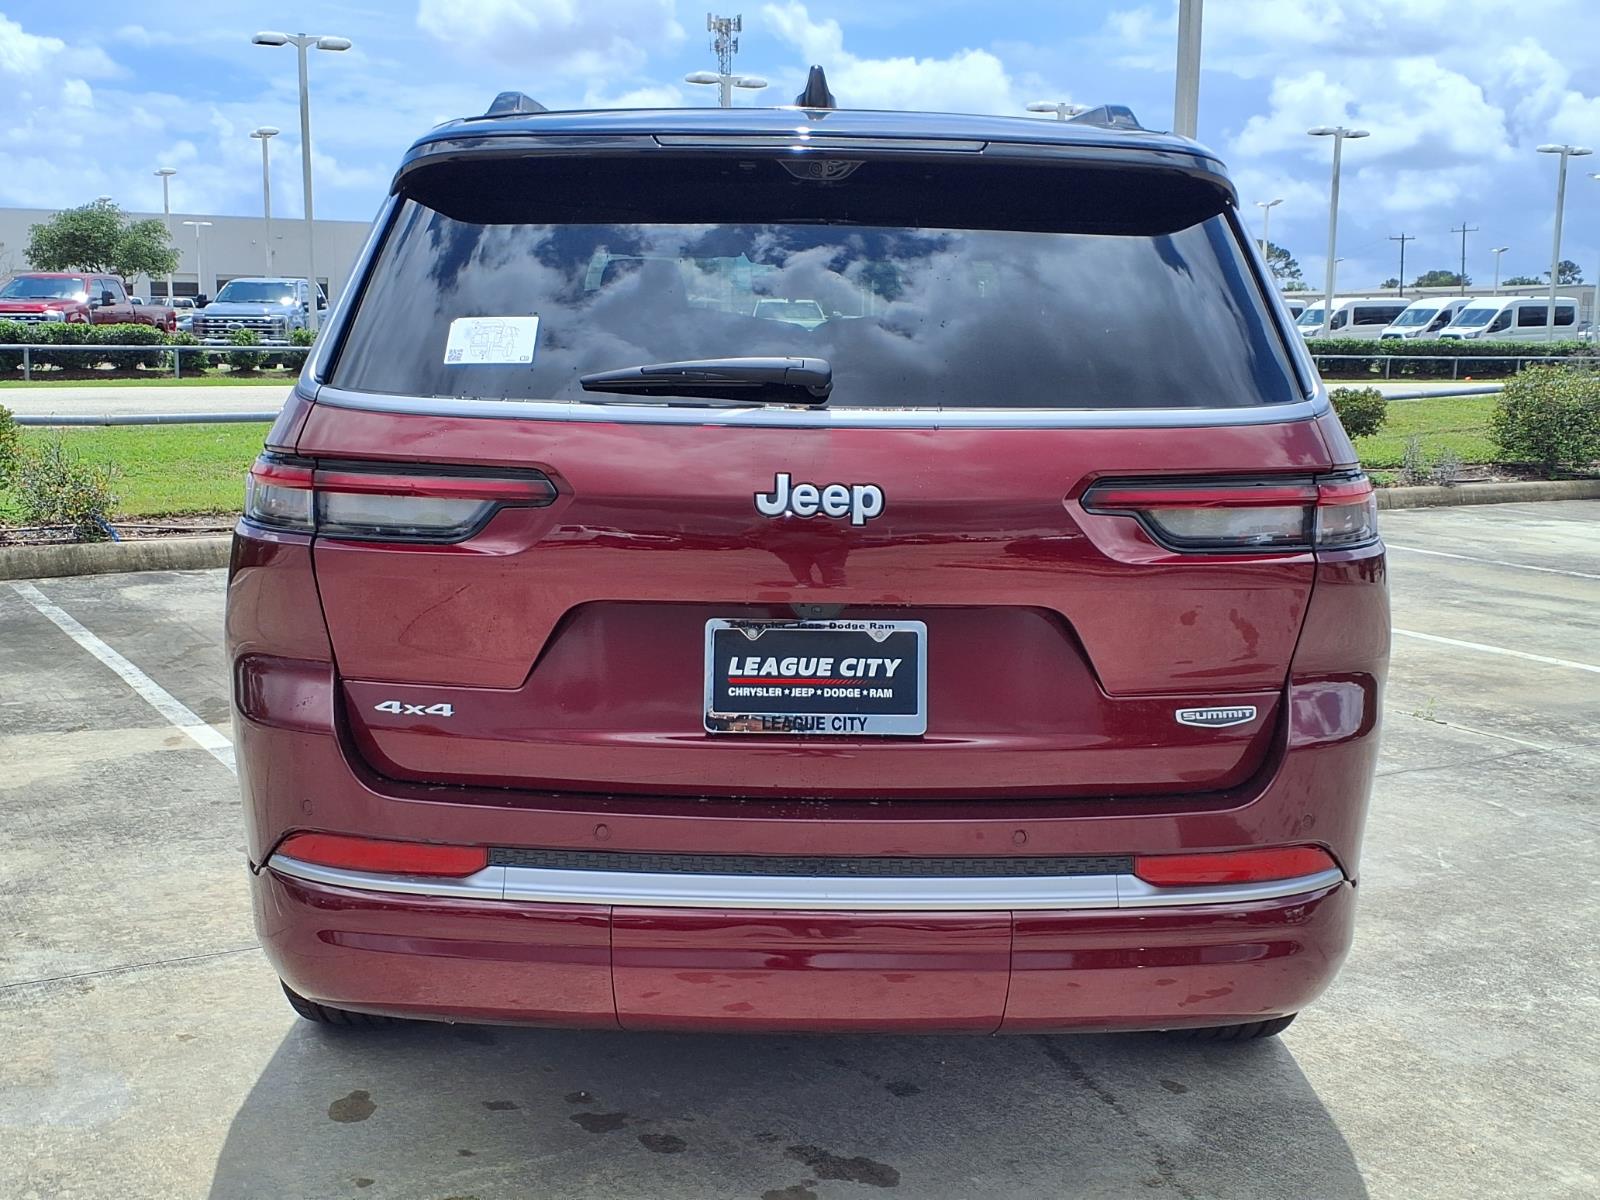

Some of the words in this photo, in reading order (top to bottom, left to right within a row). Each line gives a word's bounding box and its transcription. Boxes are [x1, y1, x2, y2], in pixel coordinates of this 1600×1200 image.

[755, 473, 884, 525] Jeep
[829, 622, 865, 630] Dodge
[870, 622, 895, 630] Ram
[728, 656, 834, 676] LEAGUE
[840, 658, 902, 677] CITY
[728, 687, 782, 697] CHRYSLER
[791, 688, 815, 697] JEEP
[823, 688, 861, 698] DODGE
[869, 689, 893, 698] RAM
[374, 700, 455, 716] 4x4
[1182, 709, 1252, 720] SUMMIT
[762, 715, 826, 731] LEAGUE
[831, 716, 868, 731] CITY
